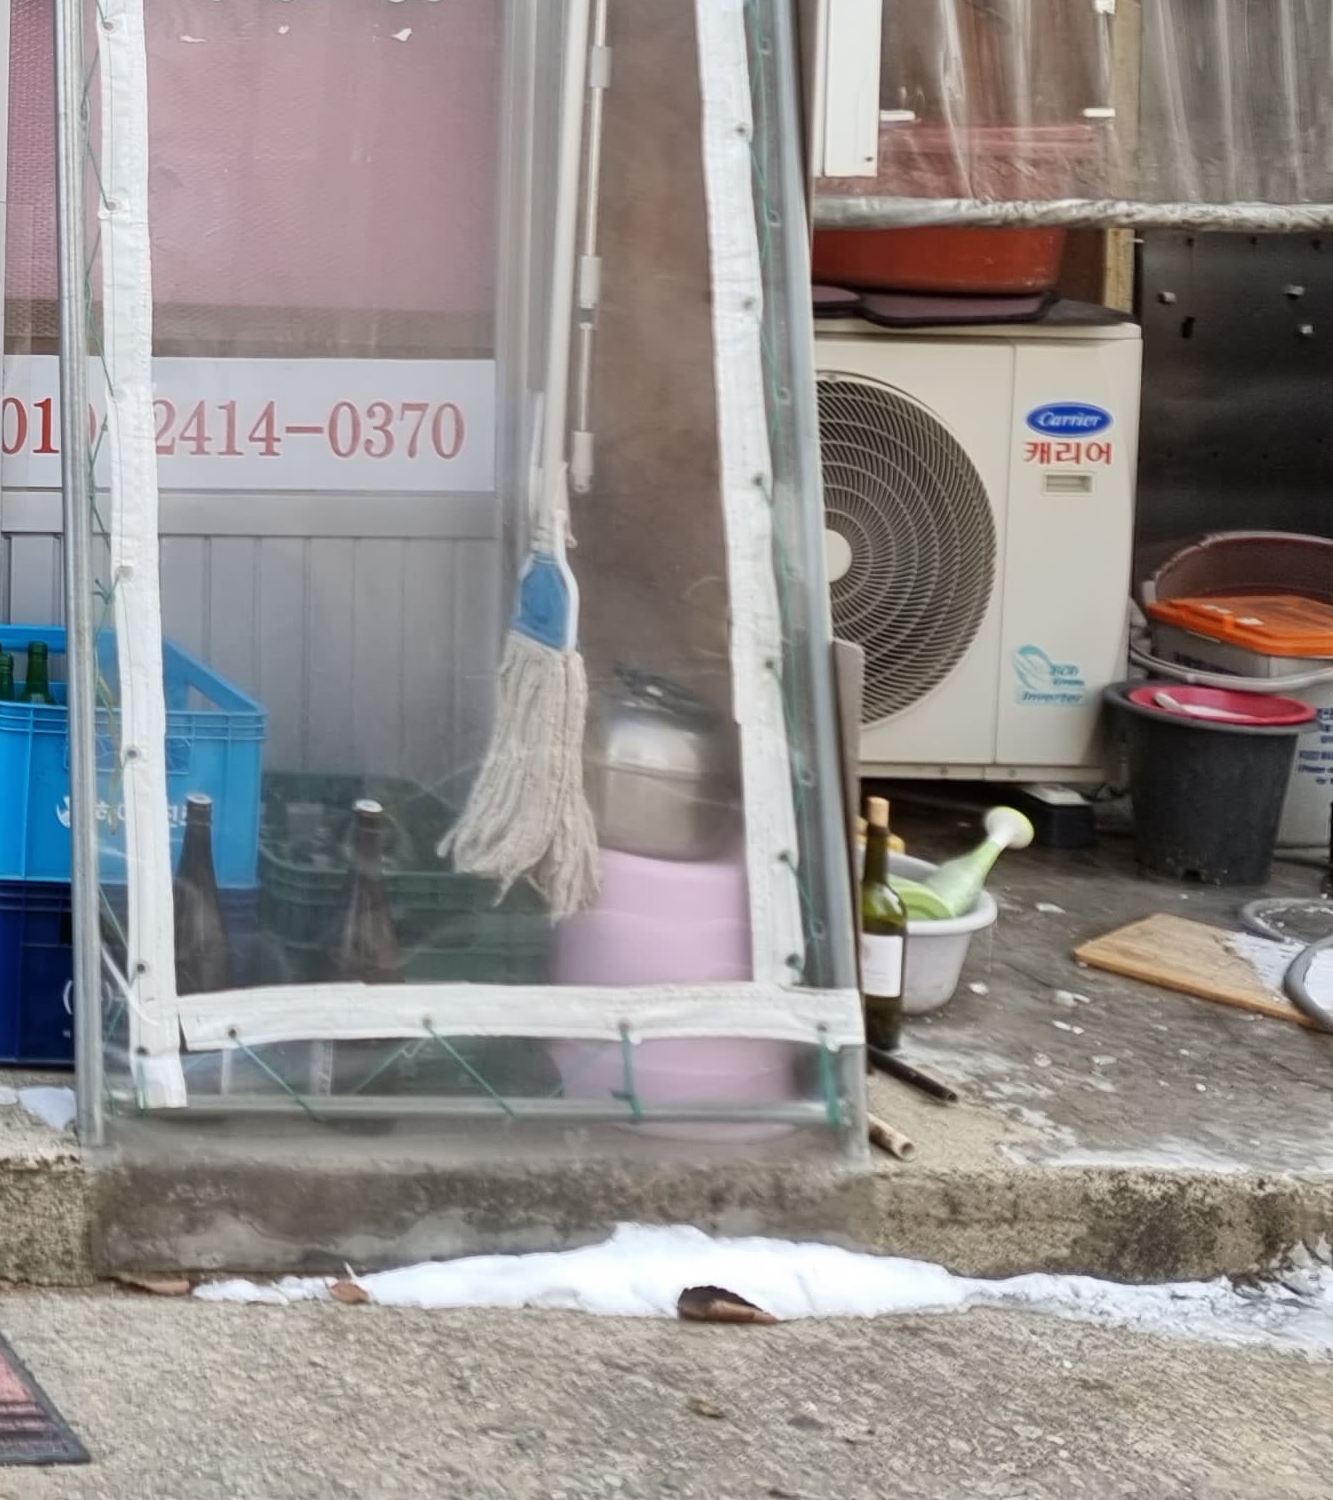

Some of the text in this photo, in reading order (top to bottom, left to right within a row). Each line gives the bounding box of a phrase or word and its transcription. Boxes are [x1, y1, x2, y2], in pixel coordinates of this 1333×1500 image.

[2, 396, 465, 460] 012414-0370
[1037, 411, 1102, 428] Carrier
[1023, 441, 1112, 465] 캐리어
